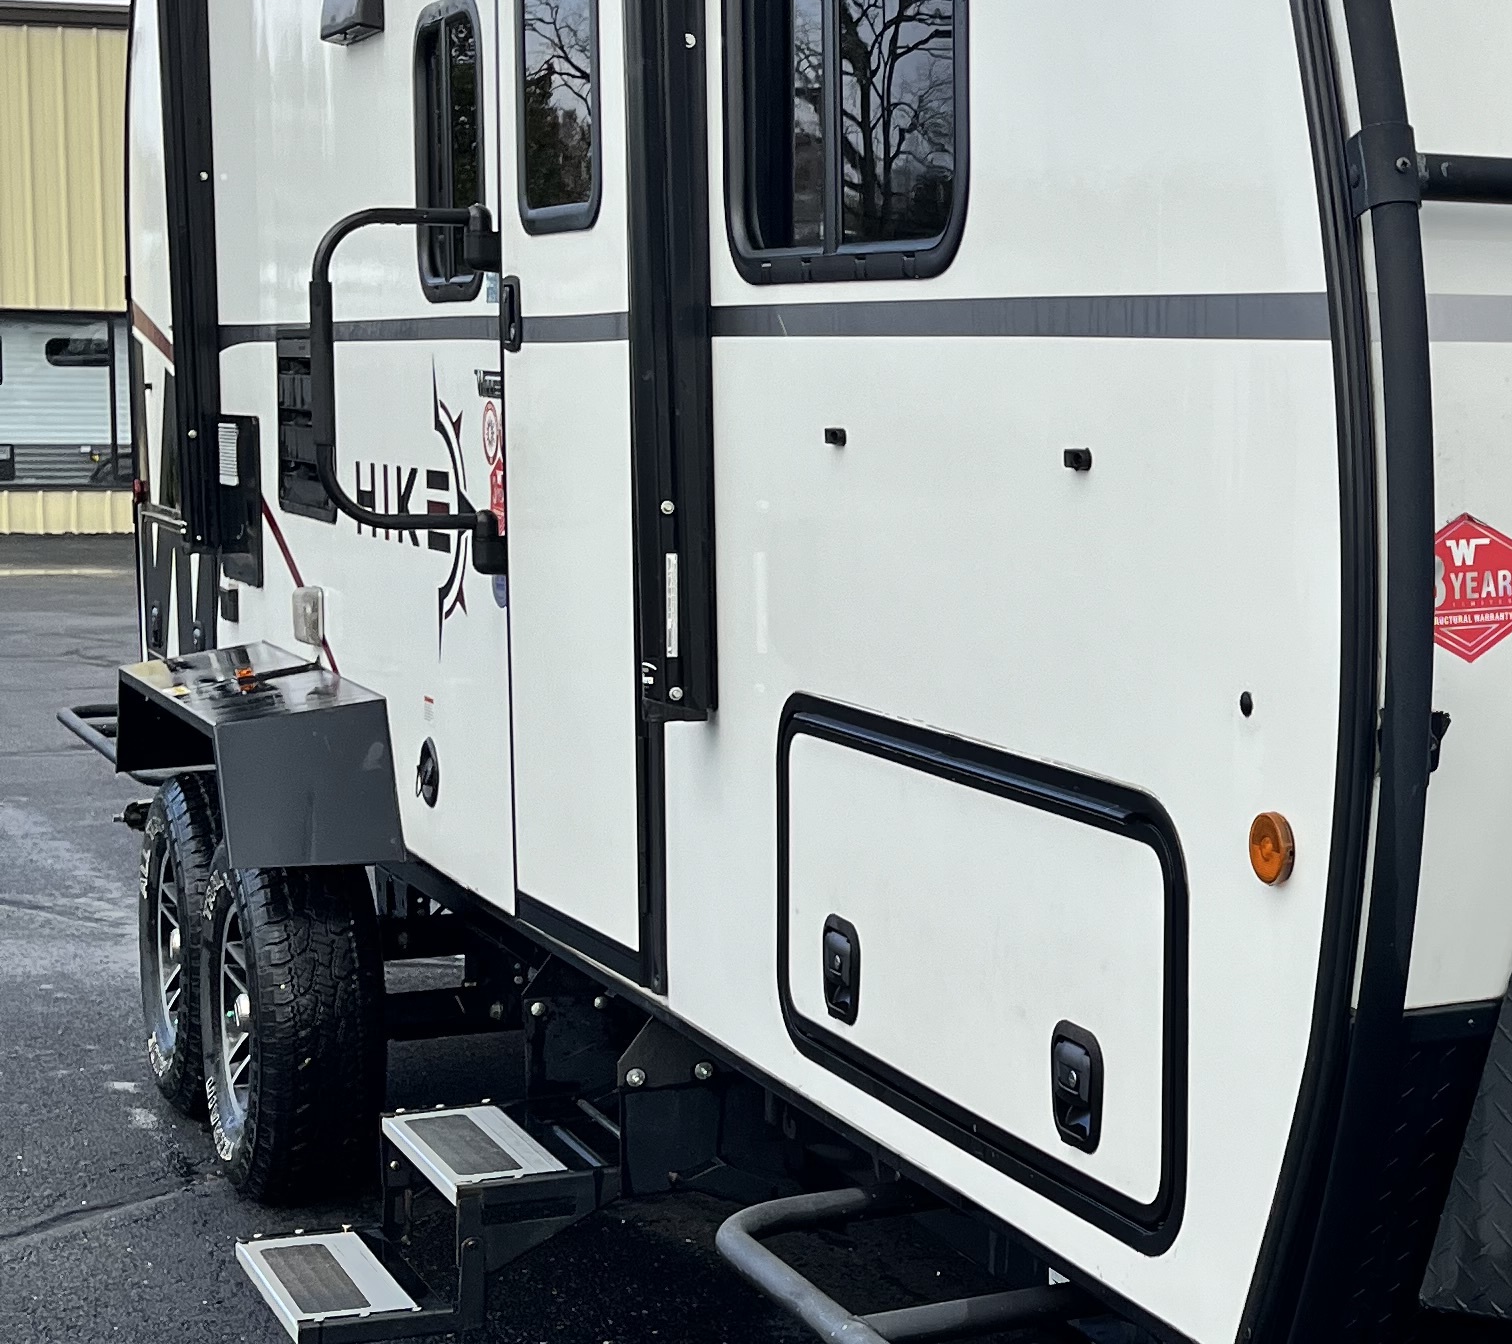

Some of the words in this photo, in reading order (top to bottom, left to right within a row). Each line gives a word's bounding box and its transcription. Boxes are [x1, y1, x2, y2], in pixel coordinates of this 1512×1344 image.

[355, 461, 451, 553] HIKE
[1450, 570, 1512, 599] YEAR
[1434, 615, 1472, 626] RUCTURAL
[1474, 611, 1512, 622] WARRANTY
